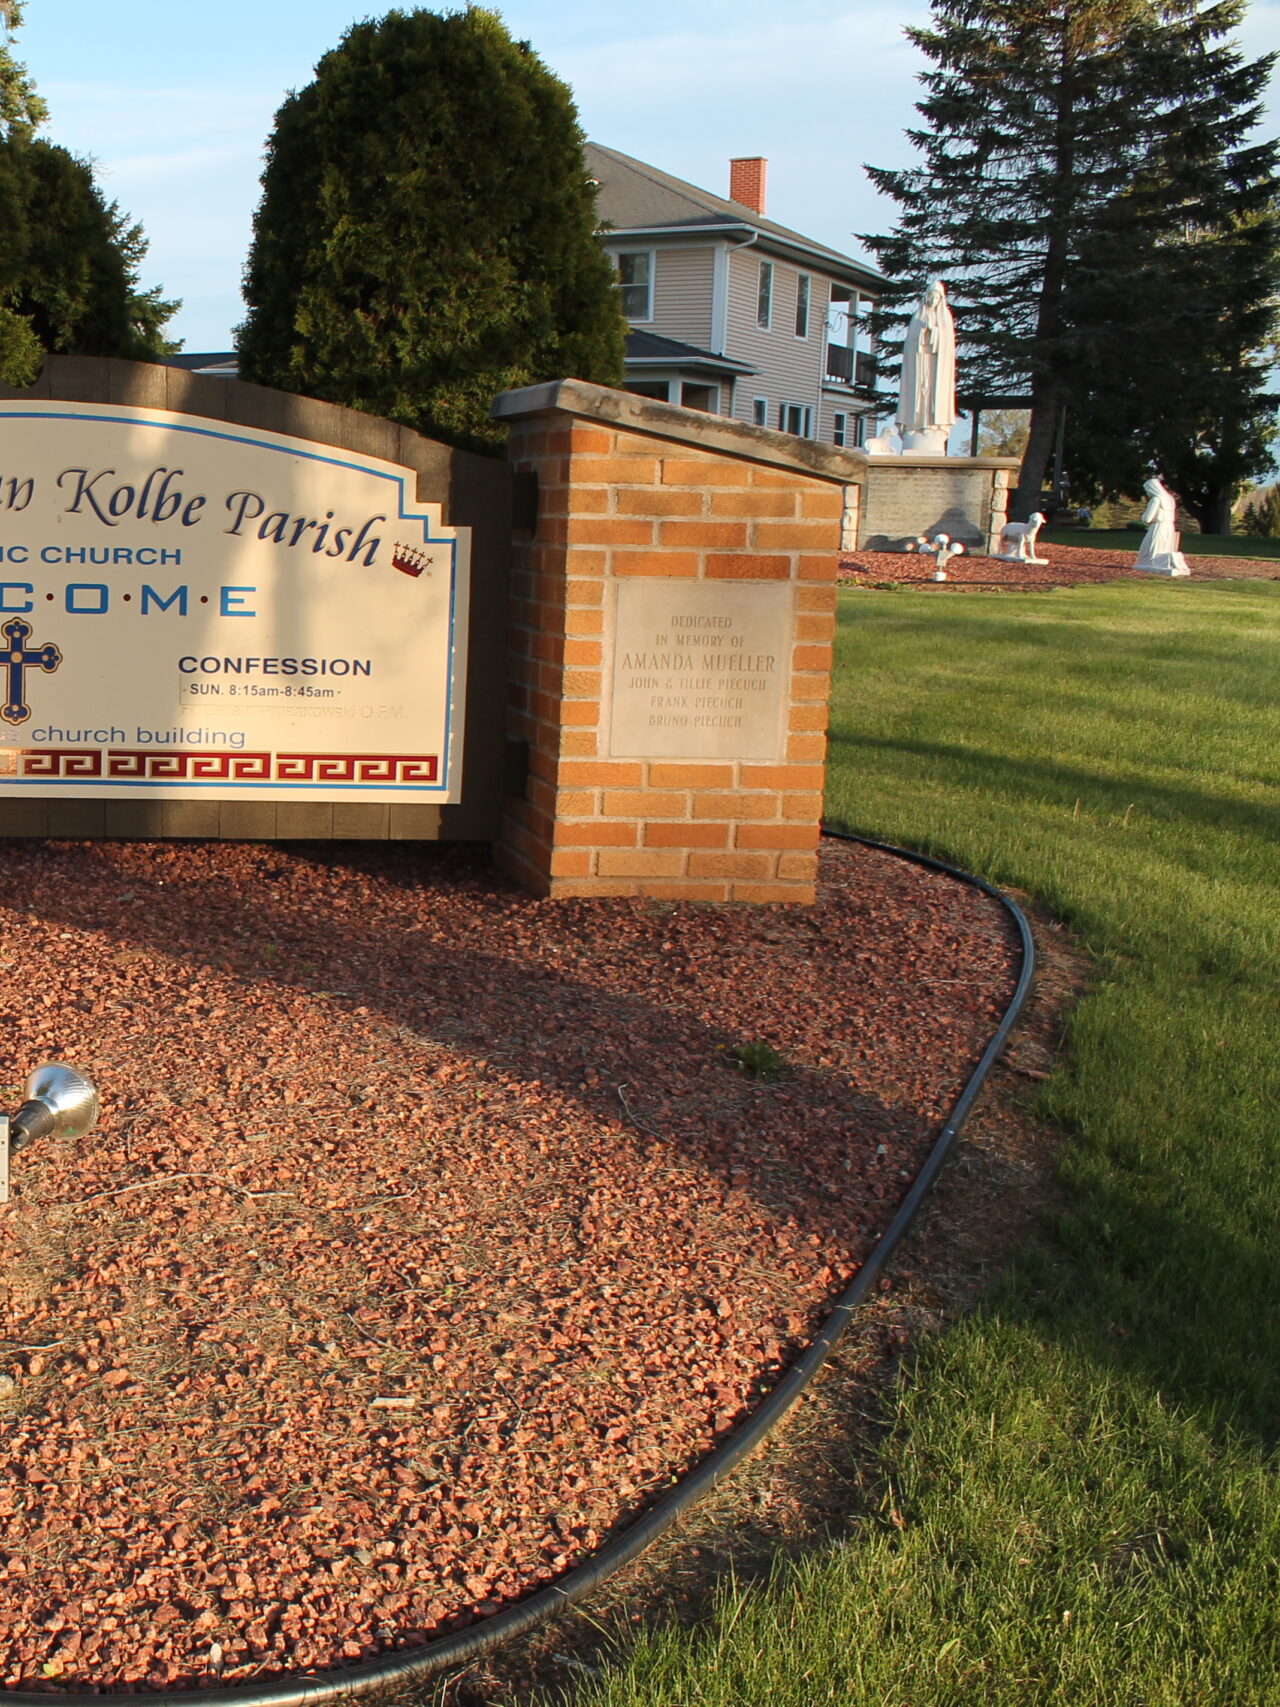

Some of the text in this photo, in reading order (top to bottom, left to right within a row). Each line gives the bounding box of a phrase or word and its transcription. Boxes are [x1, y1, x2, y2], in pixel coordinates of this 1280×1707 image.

[56, 465, 207, 528] Kolbe
[223, 490, 387, 568] Parish
[40, 546, 181, 566] CHURCH
[671, 616, 732, 628] DEDICATED
[656, 634, 744, 647] IN MEMORY OF
[178, 656, 371, 676] CONFESSION
[622, 652, 776, 672] AMANDA MUELLER
[628, 677, 659, 689] JOHN
[679, 678, 712, 690] TILLIE
[190, 684, 334, 698] SUN. 8:15am-8:45am
[650, 696, 688, 708] FRANK
[649, 715, 688, 727] BRUNO
[31, 725, 126, 743] church
[136, 727, 246, 748] building
